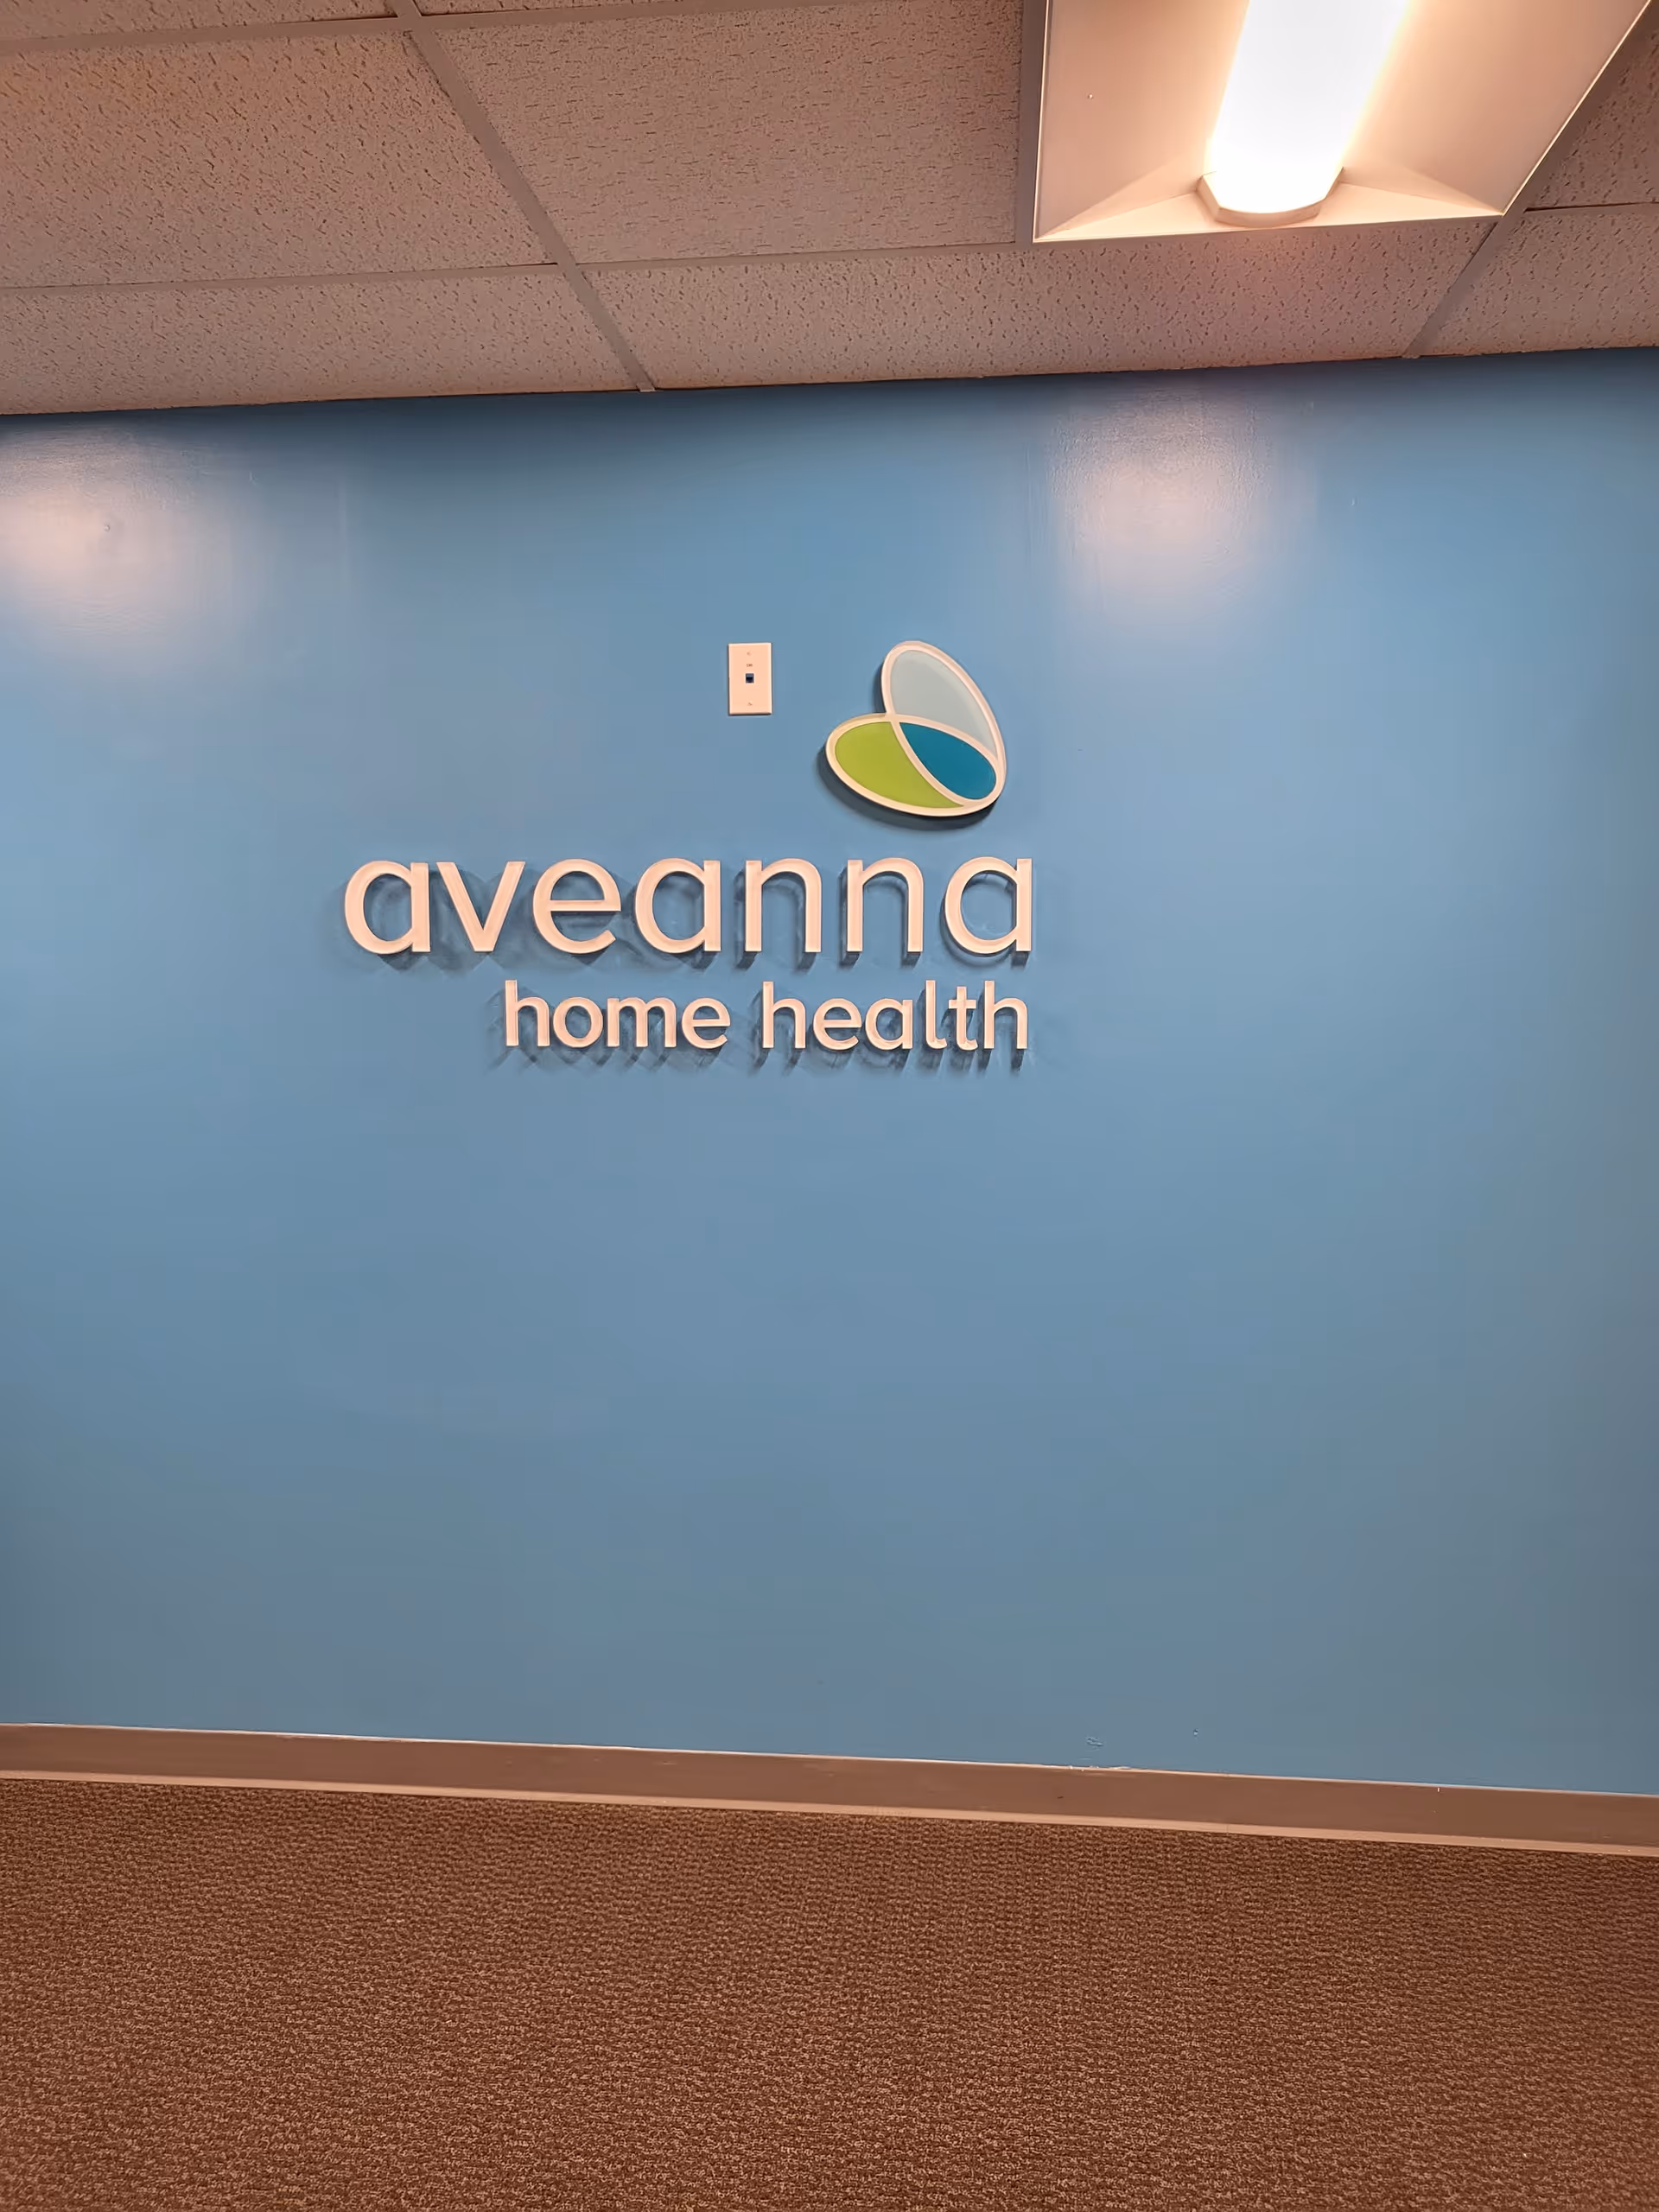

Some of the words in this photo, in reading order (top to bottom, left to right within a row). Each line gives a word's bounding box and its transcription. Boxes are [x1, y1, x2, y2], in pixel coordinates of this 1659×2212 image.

[344, 856, 1032, 955] aveanna
[505, 980, 730, 1049] home
[762, 980, 1027, 1051] health
